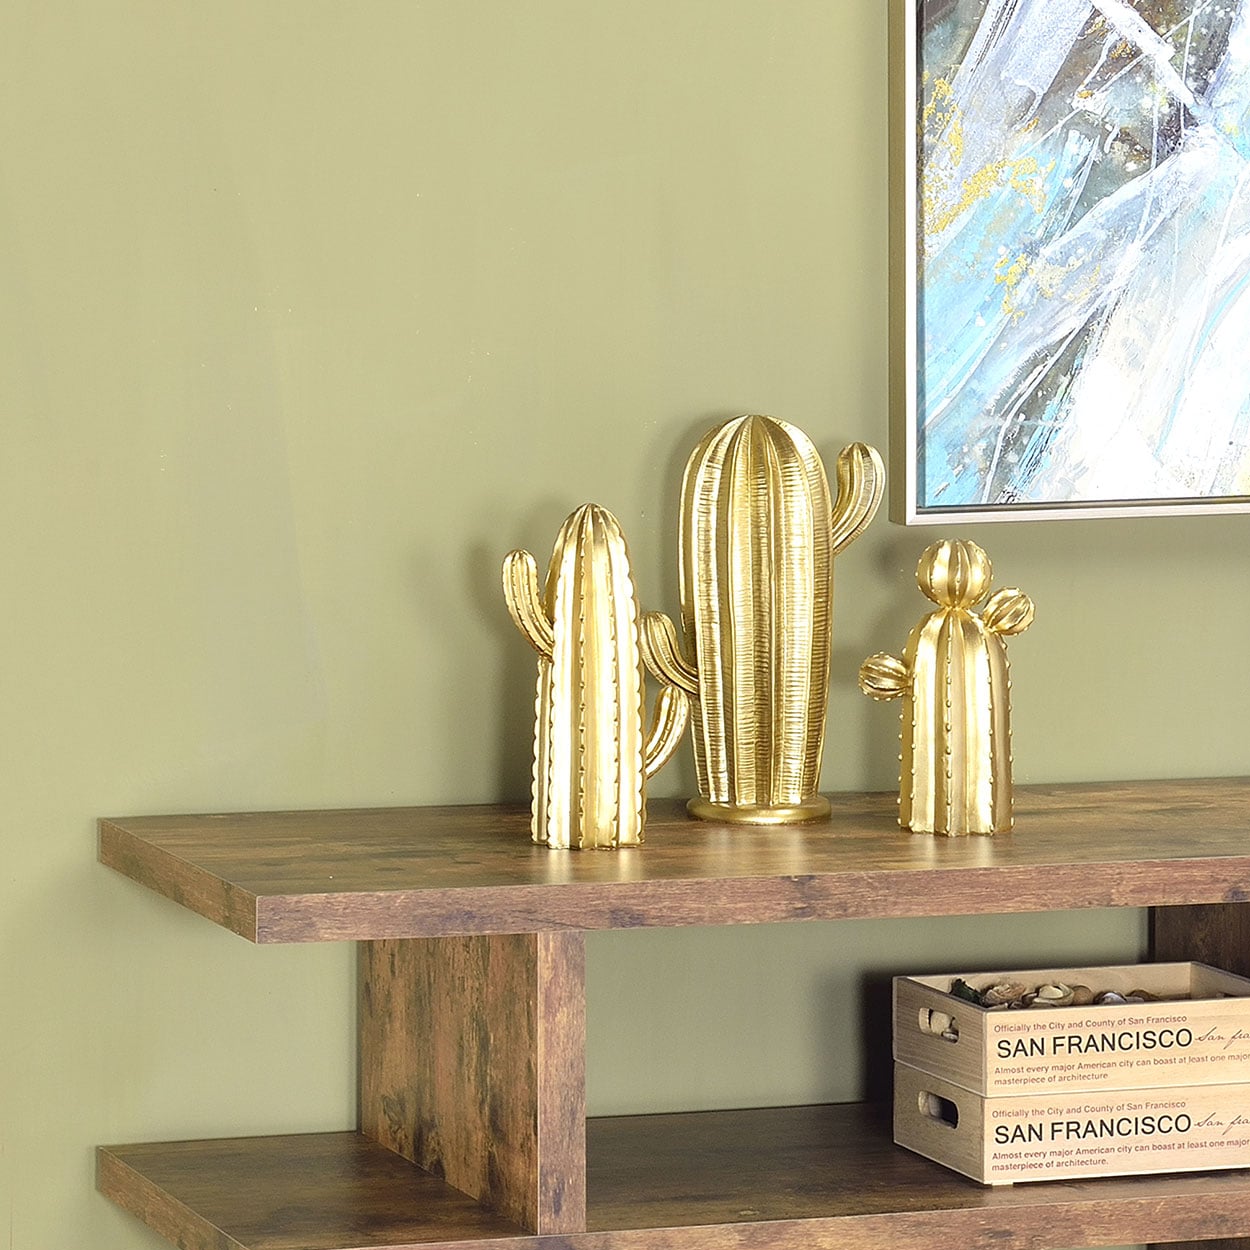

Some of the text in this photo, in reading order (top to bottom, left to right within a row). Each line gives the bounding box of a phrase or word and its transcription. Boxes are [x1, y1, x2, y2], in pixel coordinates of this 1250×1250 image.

[994, 1023, 1031, 1032] Officially
[1048, 1022, 1065, 1030] City
[1067, 1021, 1083, 1029] and
[1085, 1019, 1115, 1028] County
[1117, 1018, 1126, 1026] of
[1146, 1015, 1187, 1024] Francisco
[997, 1037, 1045, 1058] SAN
[1053, 1028, 1192, 1055] FRANCISCO
[1195, 1026, 1224, 1042] San
[994, 1066, 1024, 1074] Almost
[1026, 1065, 1050, 1074] every
[1051, 1064, 1075, 1073] major
[1077, 1062, 1117, 1070] American
[1119, 1060, 1134, 1068] city
[1153, 1057, 1176, 1065] boast
[1188, 1055, 1208, 1064] least
[1228, 1052, 1250, 1062] major
[994, 1076, 1046, 1086] masterpiece
[1059, 1072, 1108, 1082] architecture
[992, 1109, 1030, 1118] Officially
[1031, 1108, 1045, 1116] the
[1047, 1107, 1064, 1116] City
[1066, 1106, 1082, 1114] and
[1084, 1104, 1114, 1114] County
[1116, 1103, 1125, 1111] of
[1145, 1101, 1186, 1110] Francisco
[995, 1122, 1043, 1144] SAN
[1051, 1114, 1191, 1141] FRANCISCO
[1194, 1112, 1224, 1128] San
[992, 1152, 1022, 1160] Almost
[1024, 1151, 1047, 1160] every
[1049, 1149, 1073, 1158] major
[1075, 1147, 1115, 1156] American
[1117, 1144, 1132, 1153] city
[1152, 1143, 1175, 1151] boast
[1177, 1142, 1185, 1150] at
[1187, 1141, 1207, 1149] least
[1226, 1139, 1250, 1148] major
[992, 1157, 1109, 1171] masterpiece of architecture.
